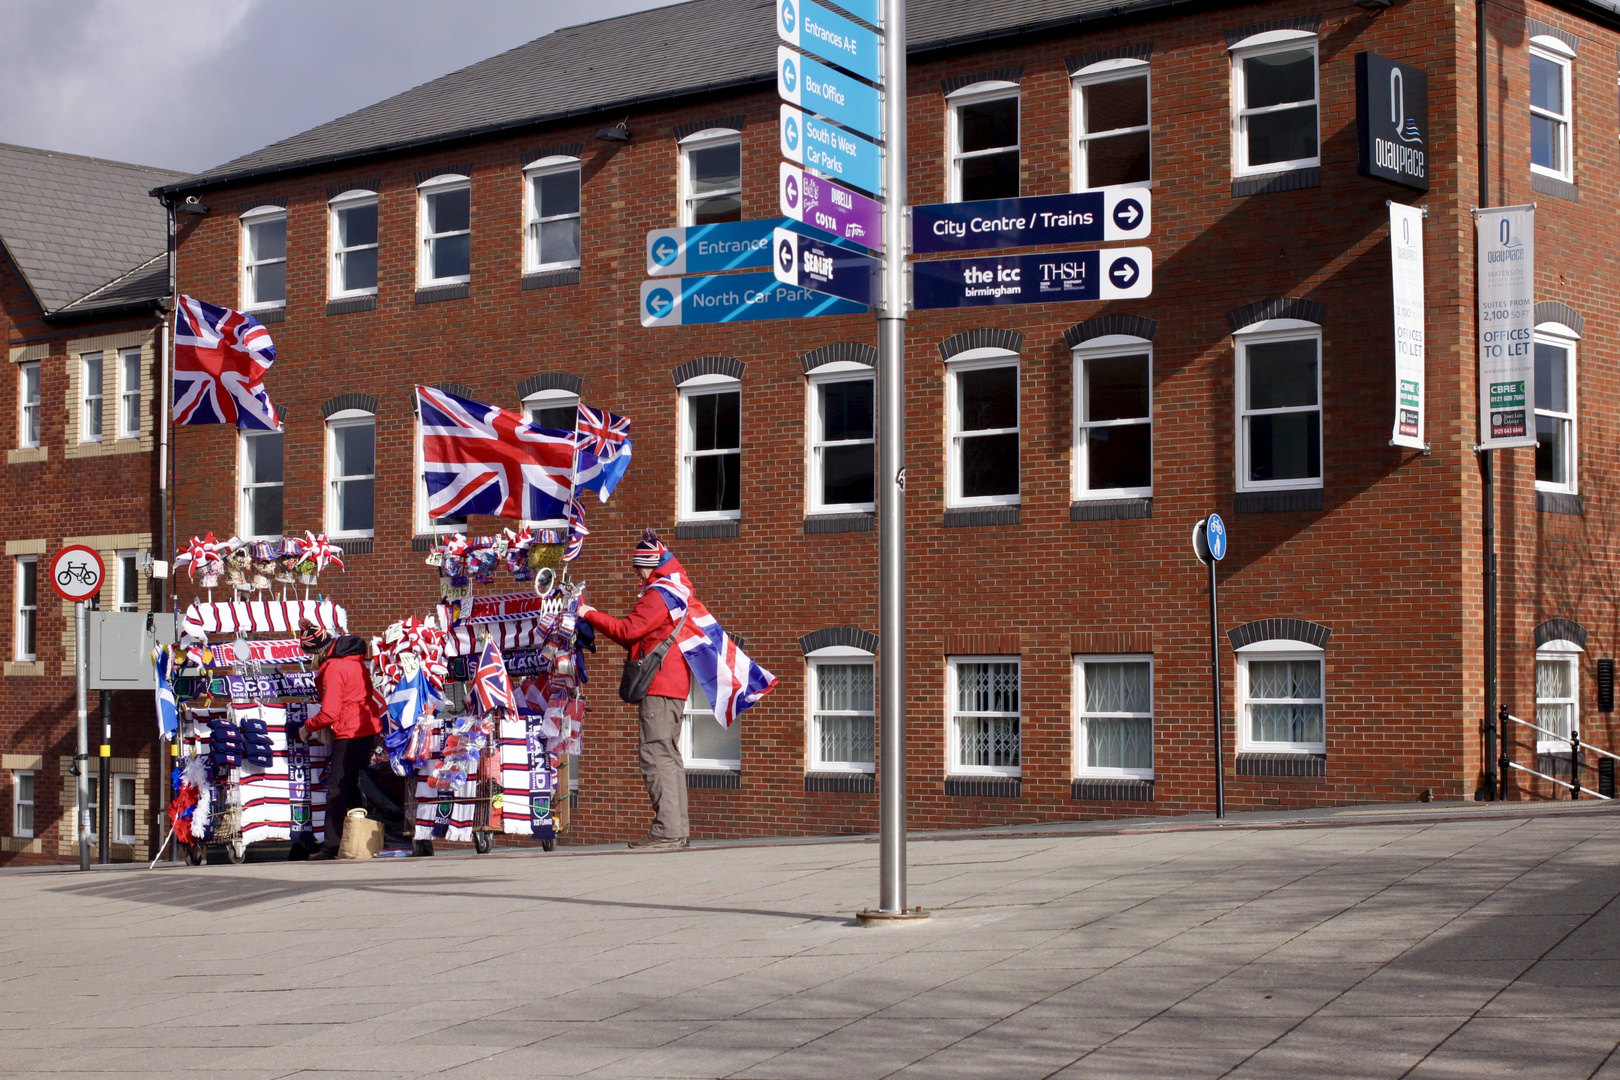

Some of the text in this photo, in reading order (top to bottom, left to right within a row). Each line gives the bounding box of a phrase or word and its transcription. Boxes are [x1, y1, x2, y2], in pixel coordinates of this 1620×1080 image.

[804, 17, 857, 54] Entrances A-E
[806, 75, 845, 106] Box Office
[806, 122, 857, 157] South & West
[806, 146, 843, 174] Car Parks
[816, 212, 837, 230] COSTA
[932, 219, 966, 237] City
[970, 216, 1026, 233] Centre
[1040, 210, 1094, 228] Trains
[698, 238, 768, 256] Entrance
[804, 250, 818, 274] SEA
[964, 265, 1021, 284] the icc
[1040, 262, 1086, 280] THSH
[1488, 269, 1524, 278] WATERSIDE
[693, 288, 814, 308] North Car Park
[965, 286, 1021, 298] birmingham
[1483, 299, 1530, 309] SUITES FROM
[1483, 310, 1509, 322] 2,100
[1511, 311, 1520, 319] SQ
[1397, 326, 1422, 342] OFFICES
[1484, 328, 1530, 342] OFFICES
[1398, 340, 1422, 357] TO LET
[1484, 342, 1530, 358] TO LET
[1491, 384, 1516, 394] CBRE
[224, 646, 266, 660] GAT
[232, 678, 316, 692] SCOTLAN
